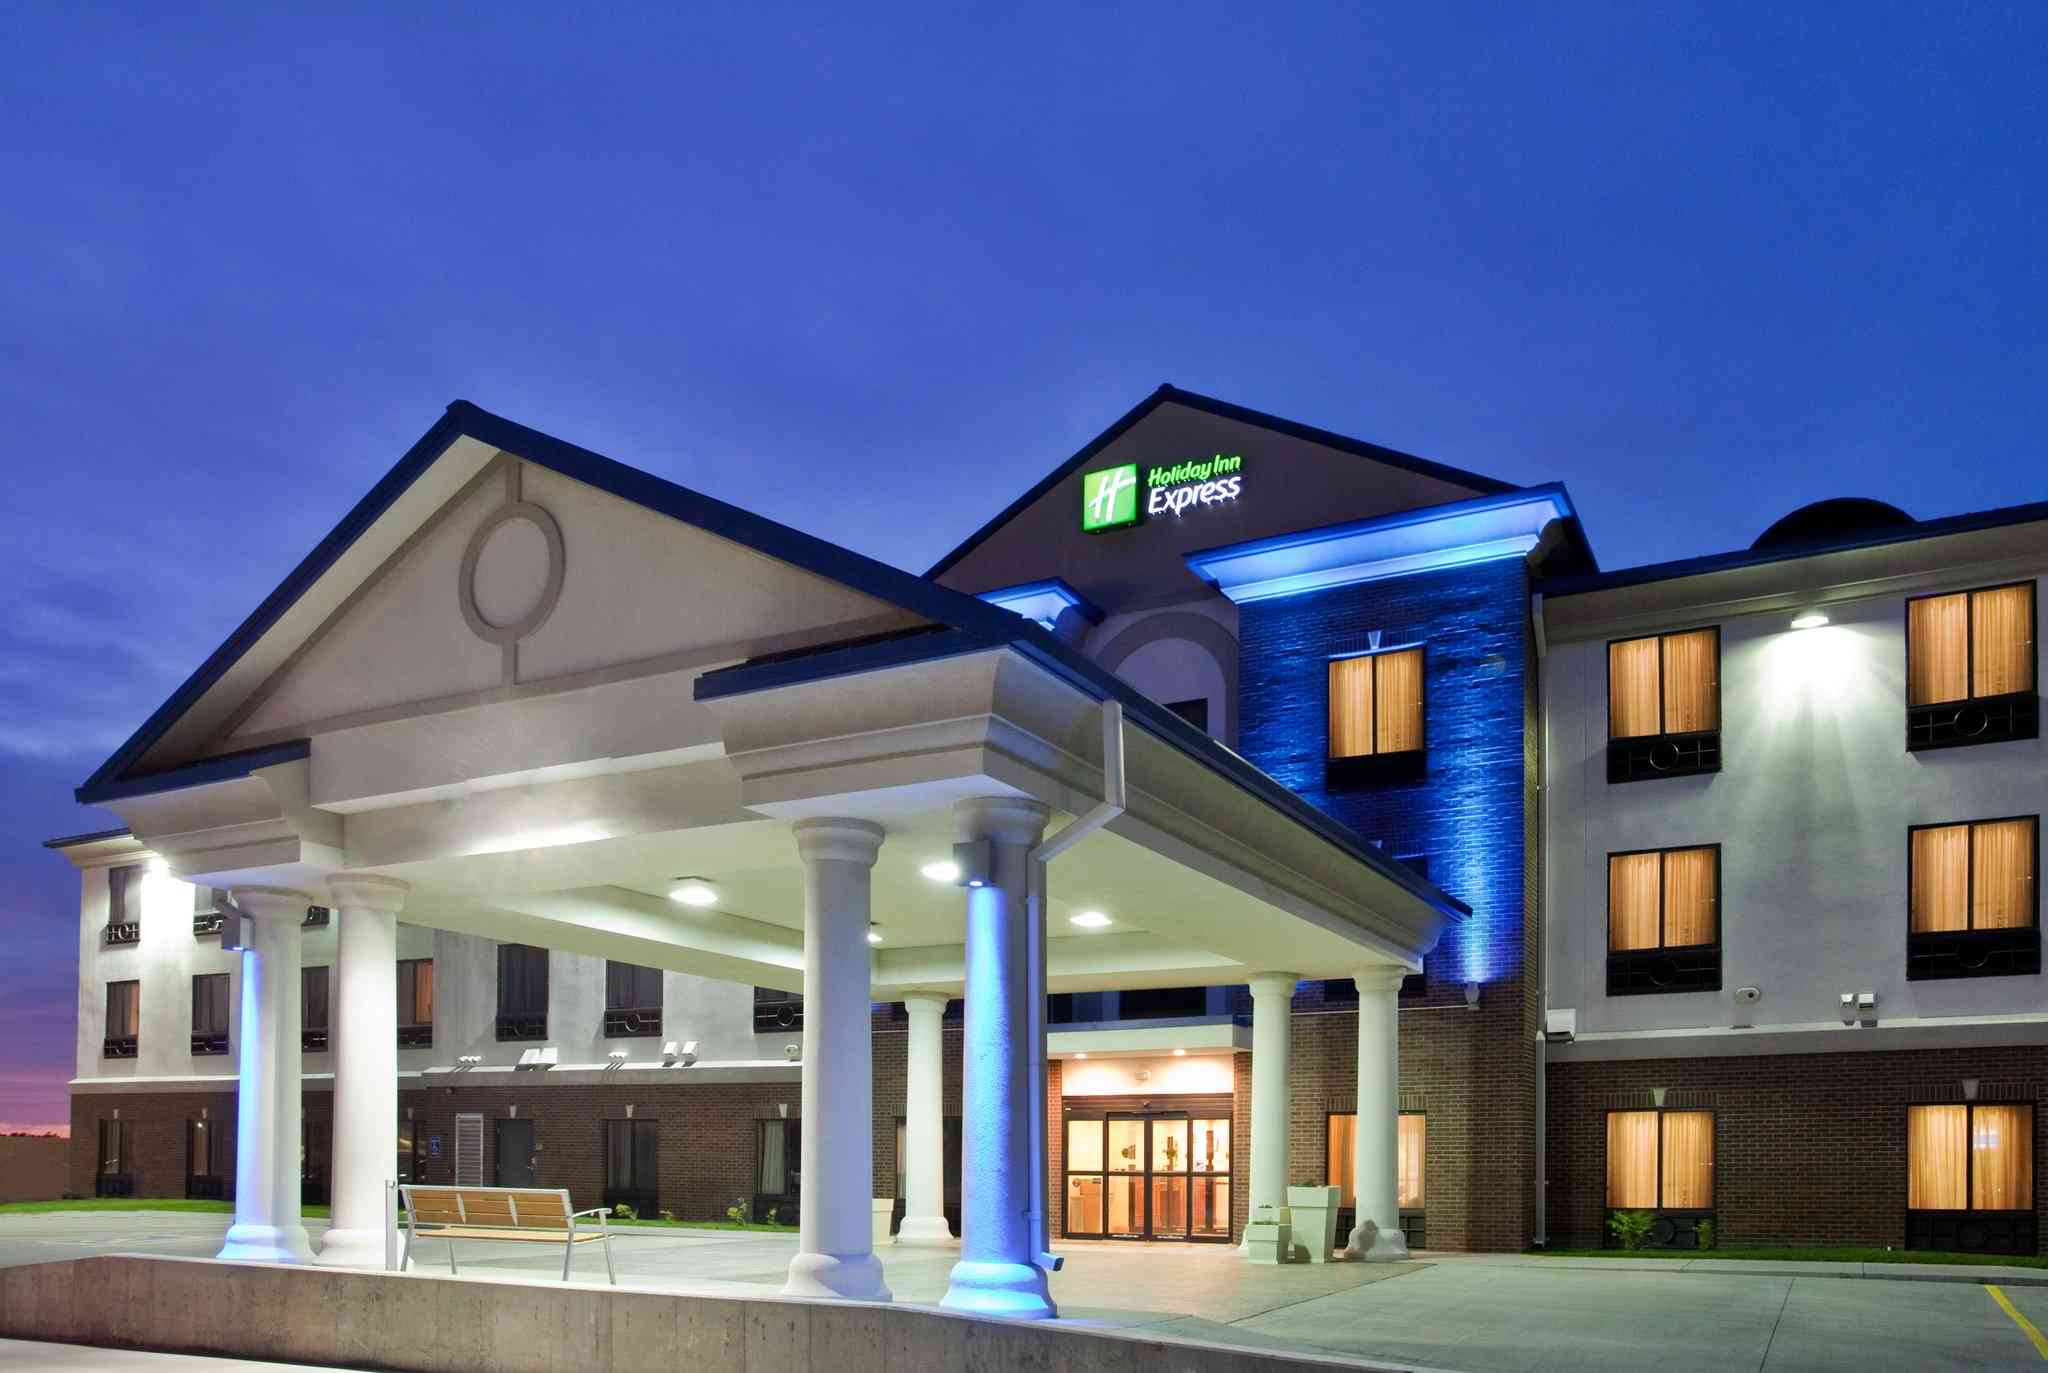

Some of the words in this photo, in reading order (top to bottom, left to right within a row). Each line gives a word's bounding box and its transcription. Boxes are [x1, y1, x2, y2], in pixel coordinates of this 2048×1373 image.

[1148, 460, 1212, 486] Holiday
[1213, 454, 1241, 475] Inn
[1148, 476, 1241, 516] Express
